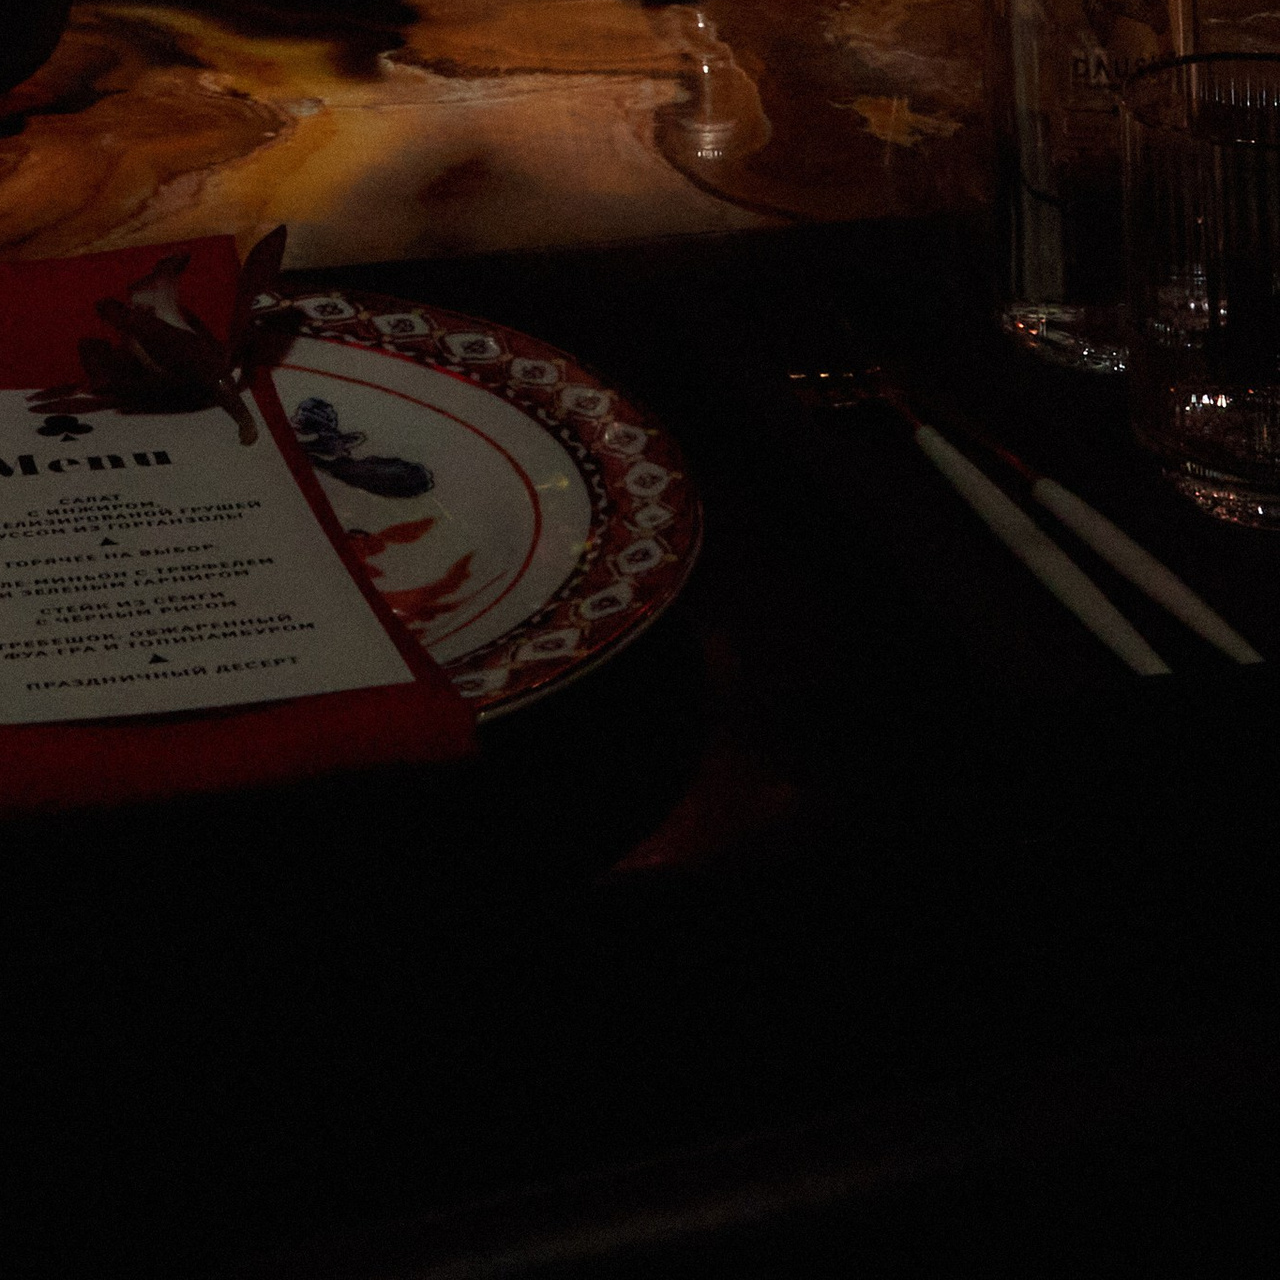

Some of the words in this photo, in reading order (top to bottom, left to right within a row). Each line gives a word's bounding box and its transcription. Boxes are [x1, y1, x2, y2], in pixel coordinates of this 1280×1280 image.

[179, 500, 262, 515] ГРУШЕЙ
[72, 524, 101, 534] ИЗ
[4, 554, 95, 569] ГОРЯЧЕЕ
[103, 551, 133, 560] НА
[155, 556, 274, 575] ТРЮФЕЛЕМ
[132, 568, 250, 587] ГАРНИРОМ
[115, 599, 146, 608] ИЗ
[159, 599, 237, 614] РИСОМ
[215, 655, 297, 674] ДЕСЕРТ
